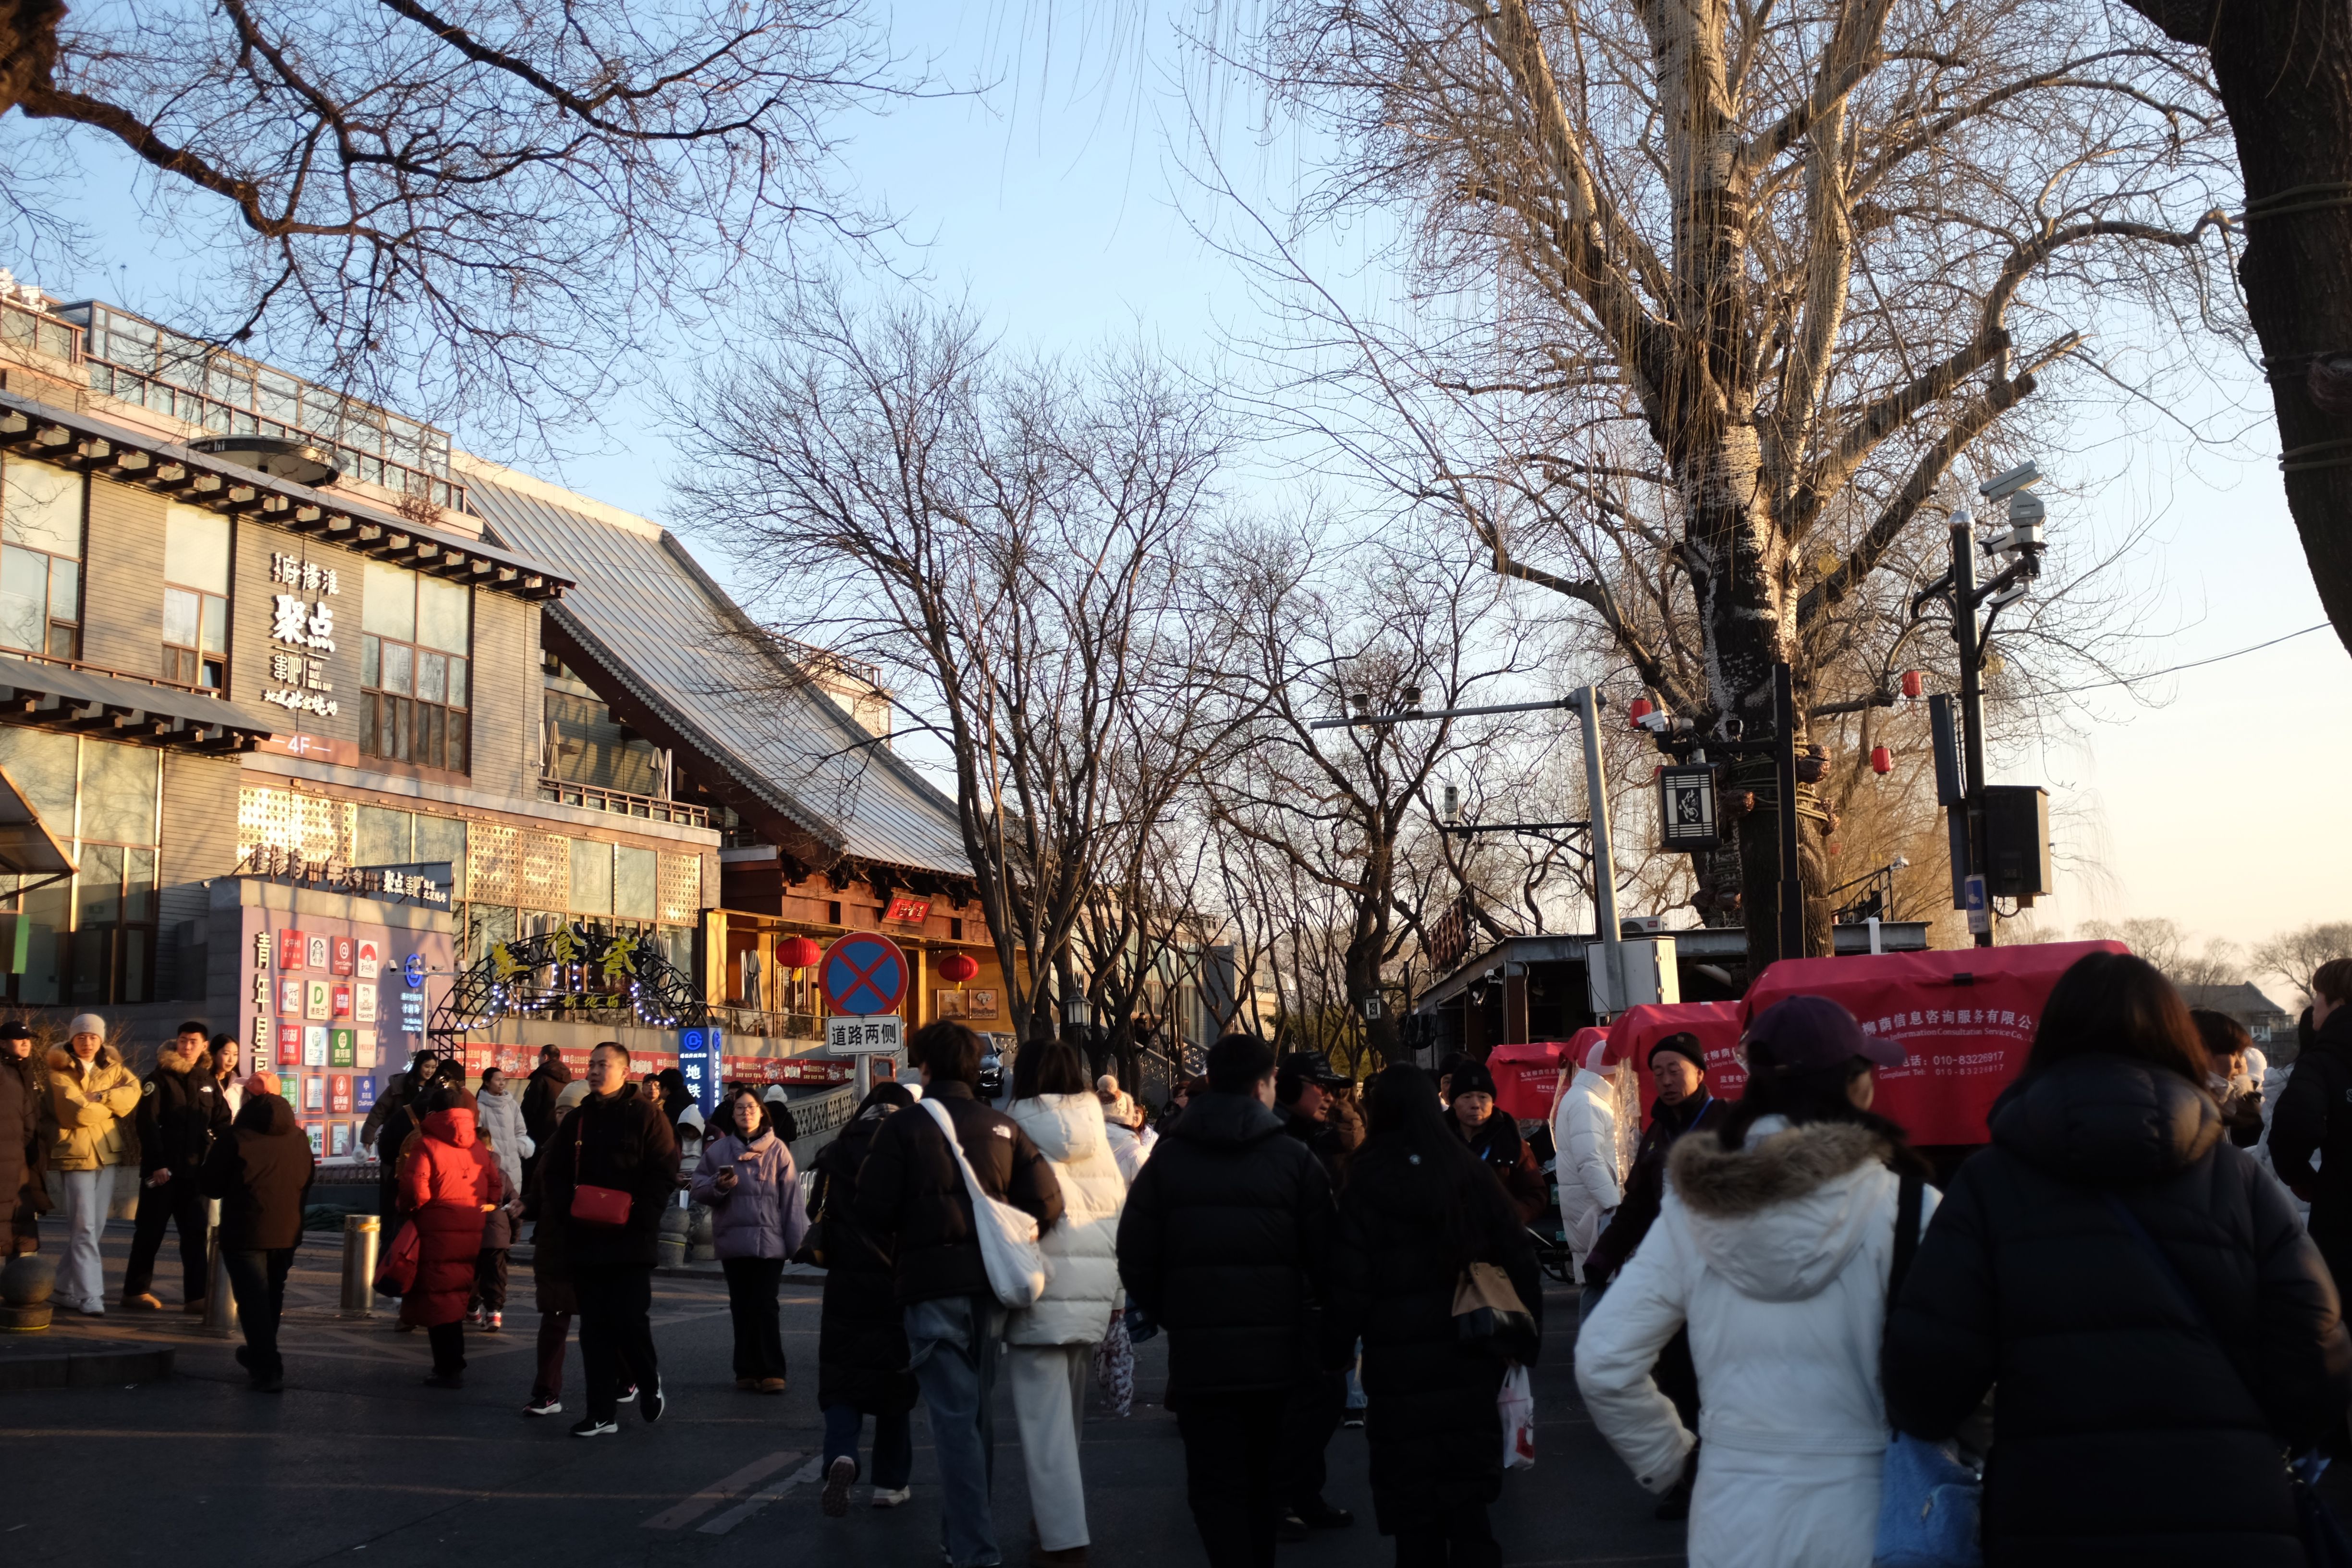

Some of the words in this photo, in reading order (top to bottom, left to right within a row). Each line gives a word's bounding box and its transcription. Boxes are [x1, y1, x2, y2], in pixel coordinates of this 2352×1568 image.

[273, 595, 335, 652] 聚点
[287, 735, 310, 754] 4F
[1862, 1009, 2040, 1036] 柳荫信息咨询服务有限公
[832, 1023, 896, 1046] 道路两侧
[1889, 1029, 1937, 1041] Information
[1984, 1028, 2010, 1036] Service
[1933, 1051, 2004, 1065] 010-83226917
[1879, 1070, 1911, 1079] Complaint
[686, 1065, 702, 1108] 地铁
